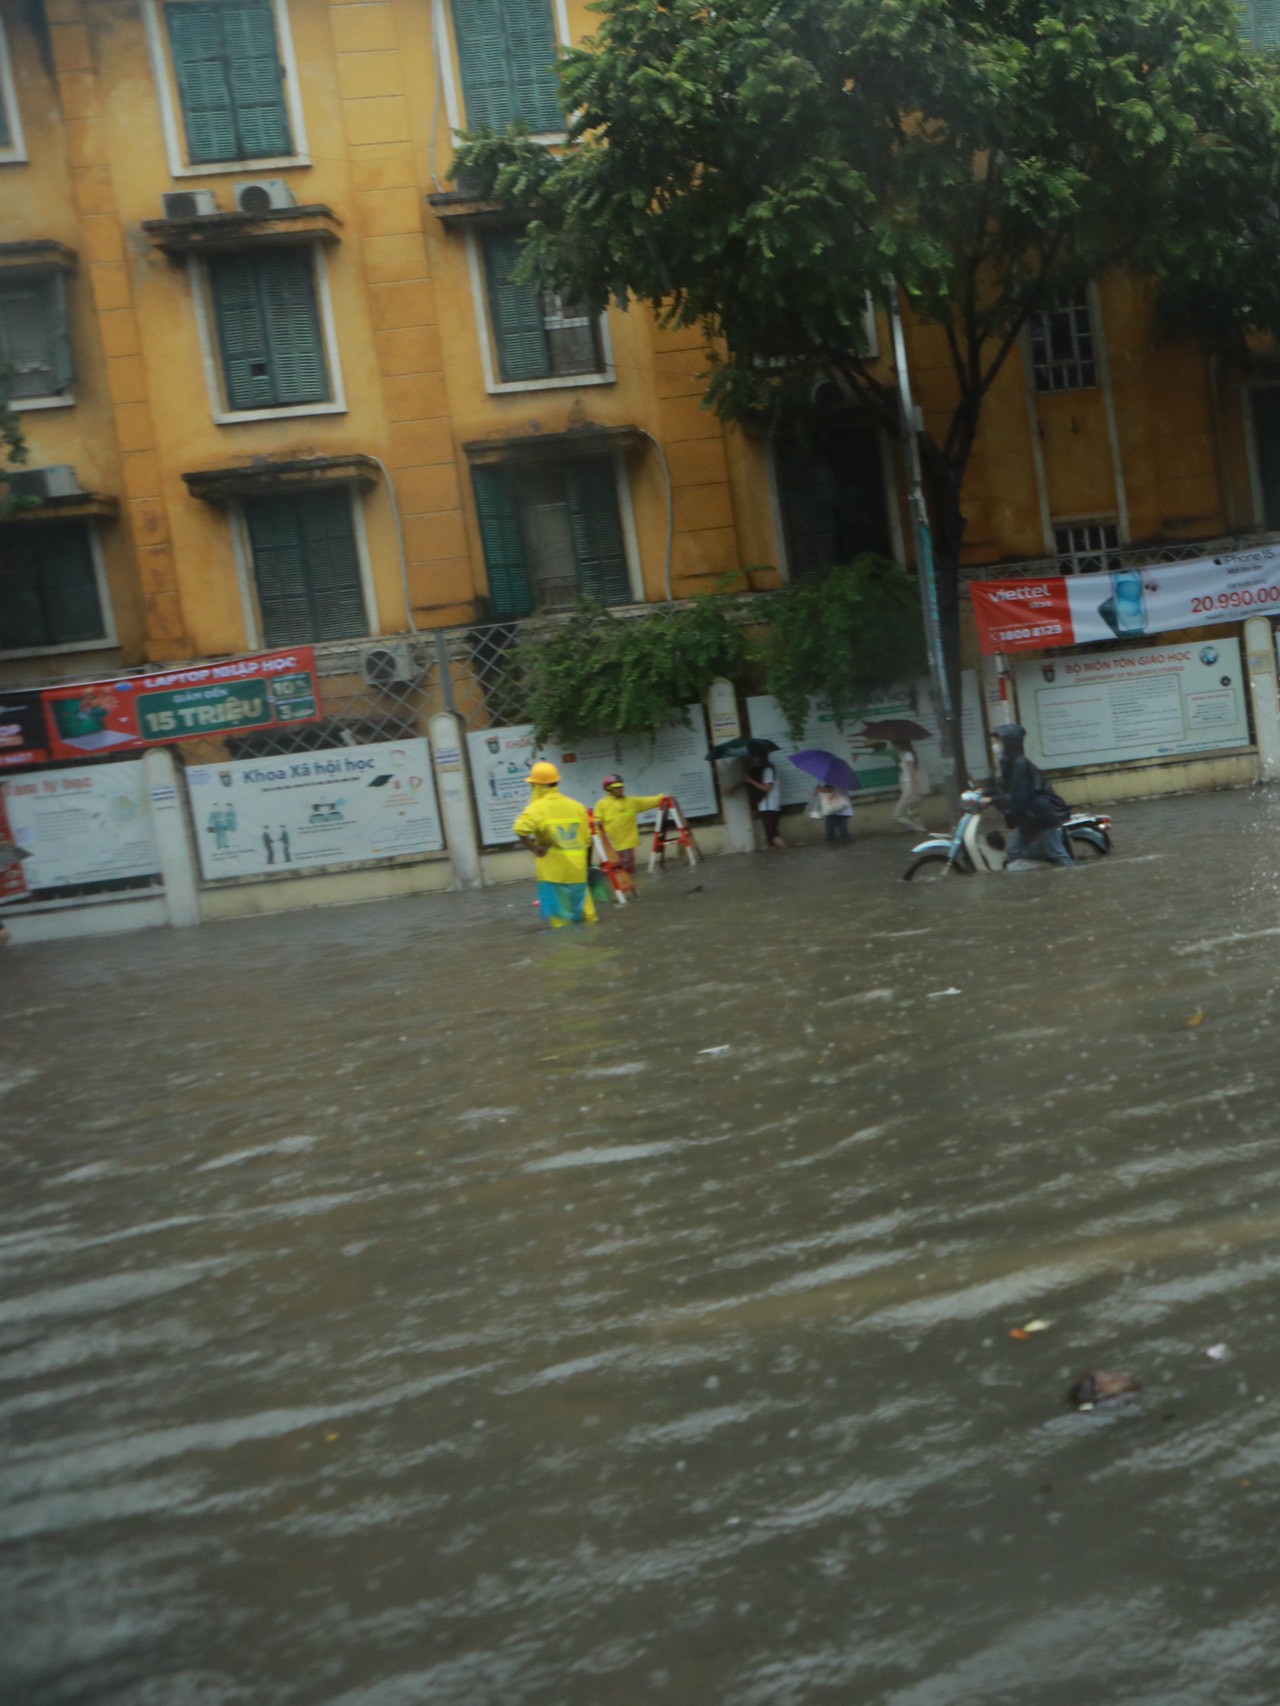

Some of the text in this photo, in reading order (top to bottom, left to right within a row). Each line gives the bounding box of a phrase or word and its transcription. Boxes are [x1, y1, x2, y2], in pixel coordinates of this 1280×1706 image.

[988, 584, 1052, 602] viettel
[144, 669, 211, 688] LAPTOP
[262, 657, 297, 672] HỌC
[145, 696, 263, 732] 15 TRIỆU
[242, 767, 286, 785] Khoa
[289, 763, 311, 778] Xã
[314, 759, 343, 777] hội
[344, 756, 375, 774] học
